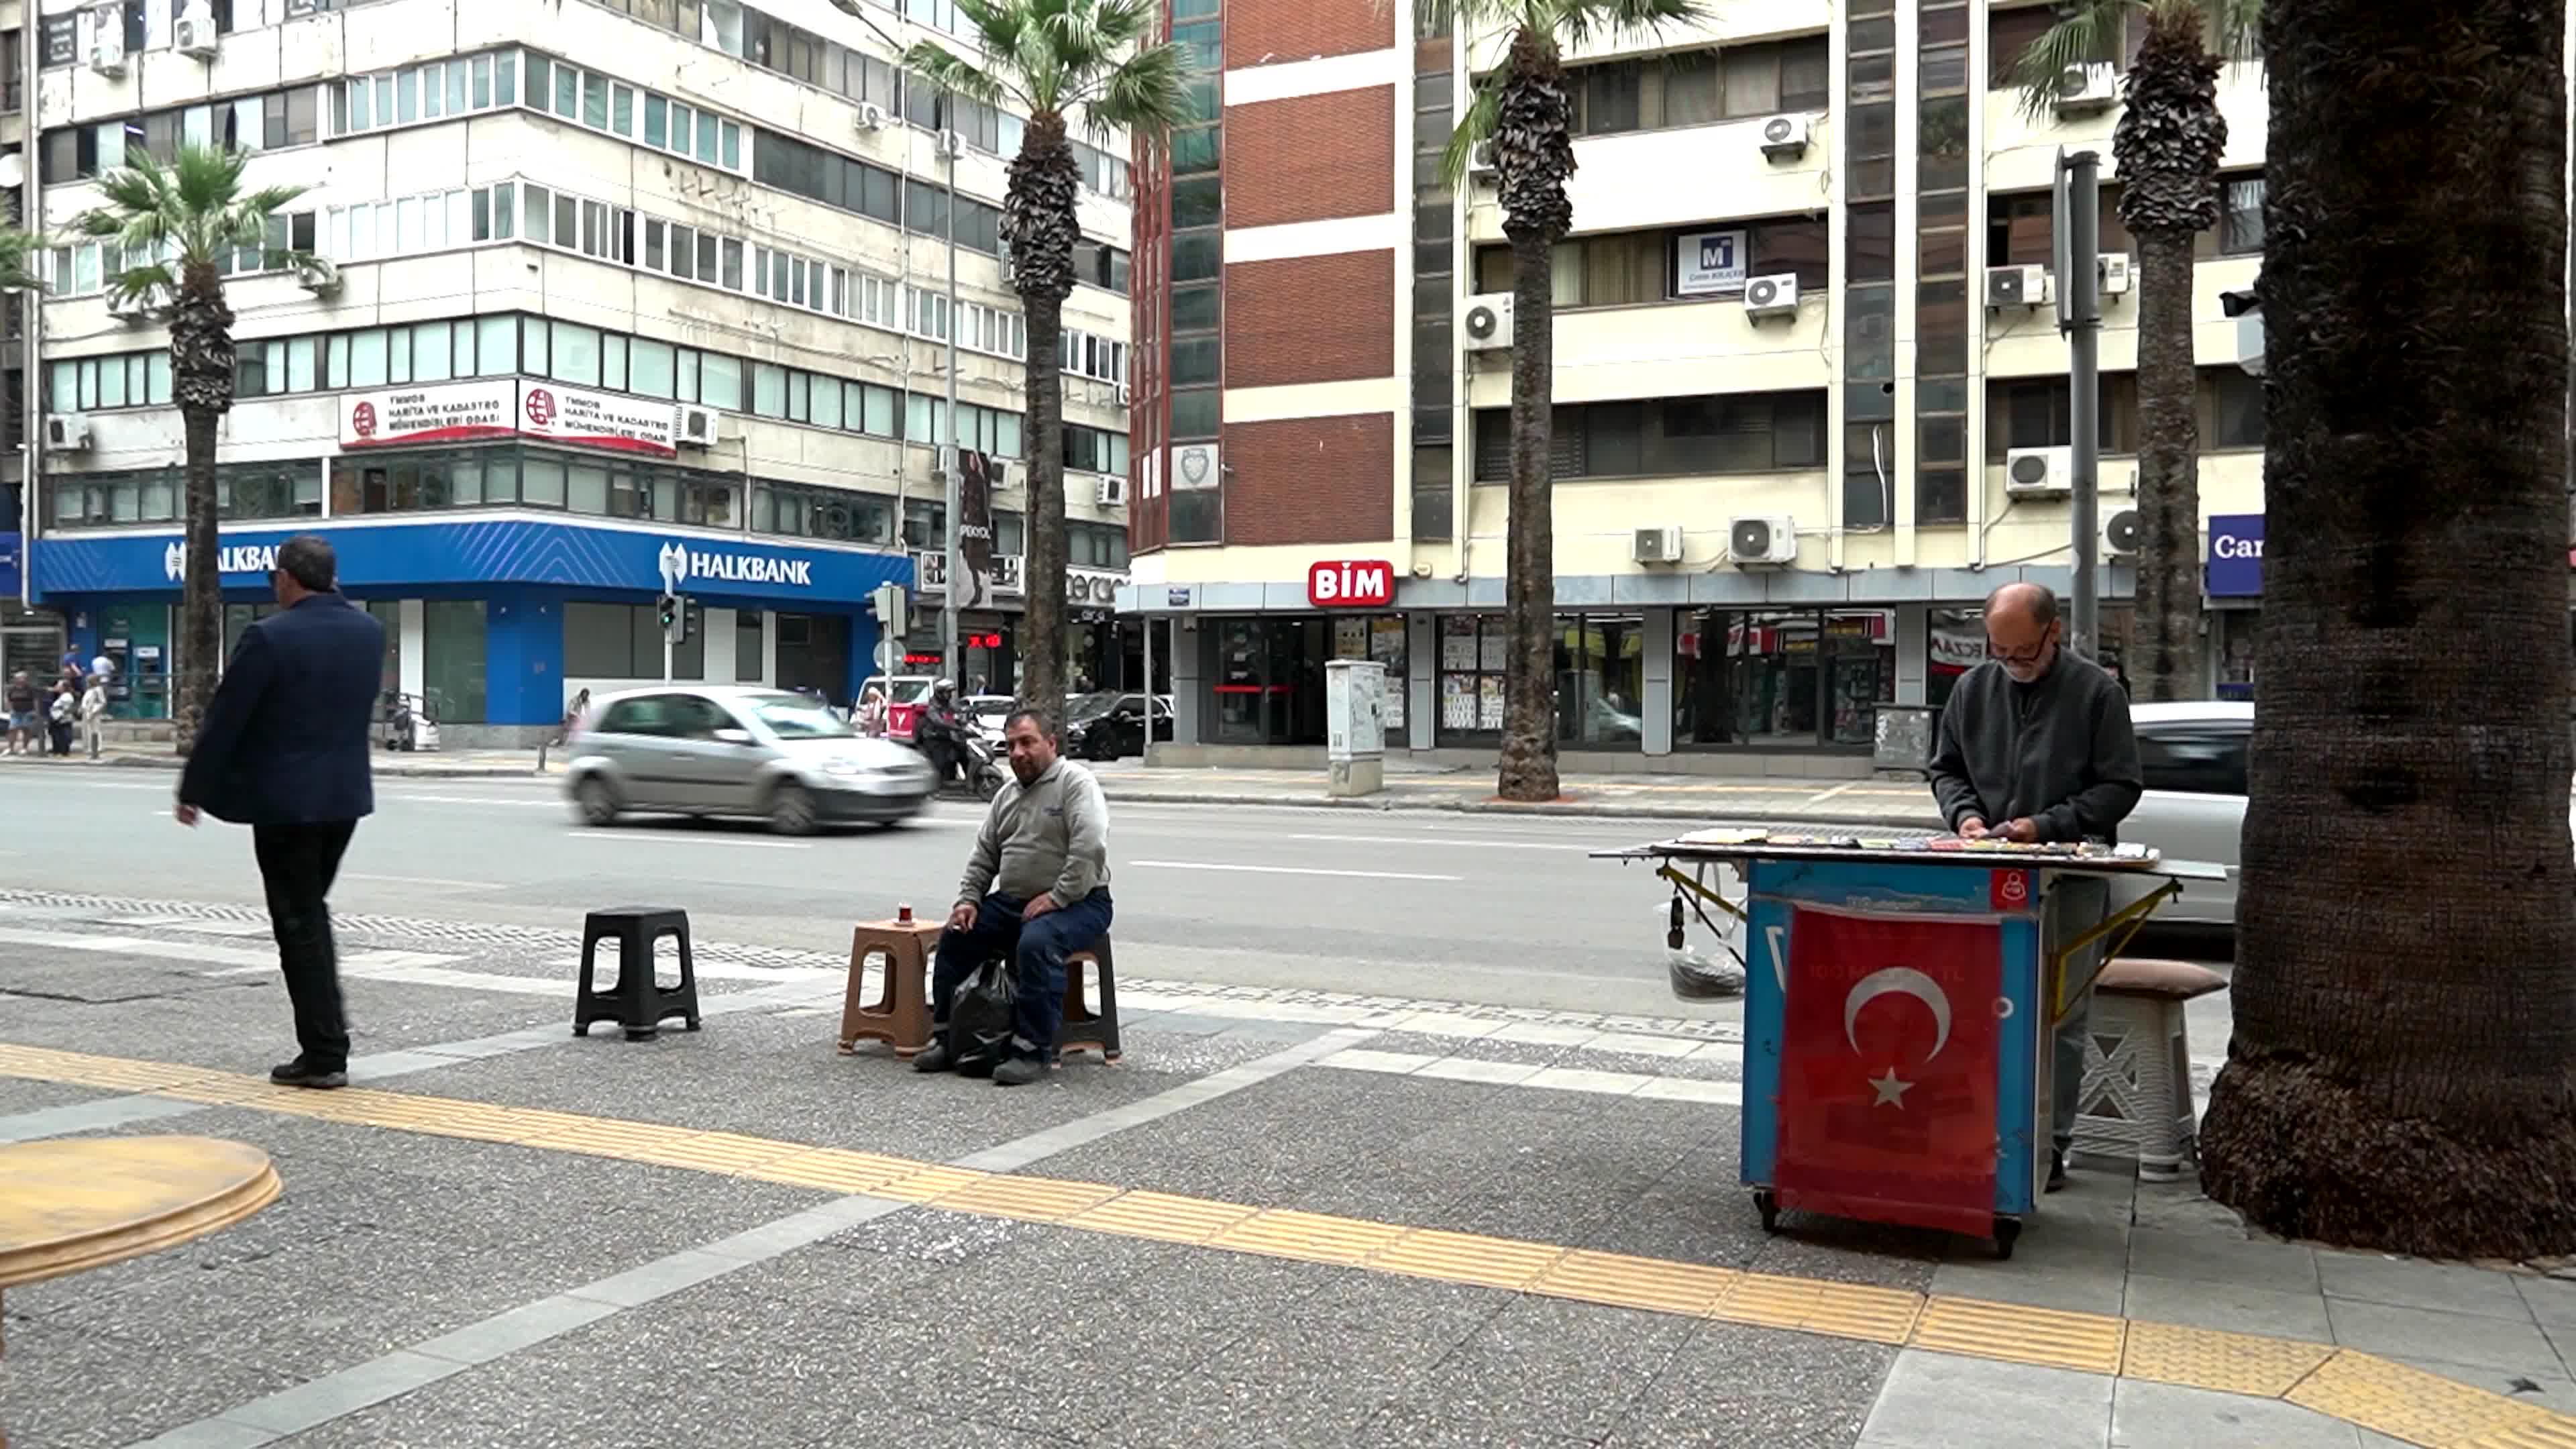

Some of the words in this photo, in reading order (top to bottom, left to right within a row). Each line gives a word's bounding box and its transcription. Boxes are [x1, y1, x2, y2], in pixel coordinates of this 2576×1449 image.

[389, 404, 424, 418] HARİTA
[427, 405, 439, 414] VE
[442, 400, 500, 413] KADASTRO
[565, 396, 600, 409] TMMOB
[565, 407, 600, 421] HARİTA
[602, 413, 614, 423] VE
[617, 415, 668, 430] KADASTRO
[692, 552, 811, 586] HALKBANK
[1315, 562, 1385, 600] BİM
